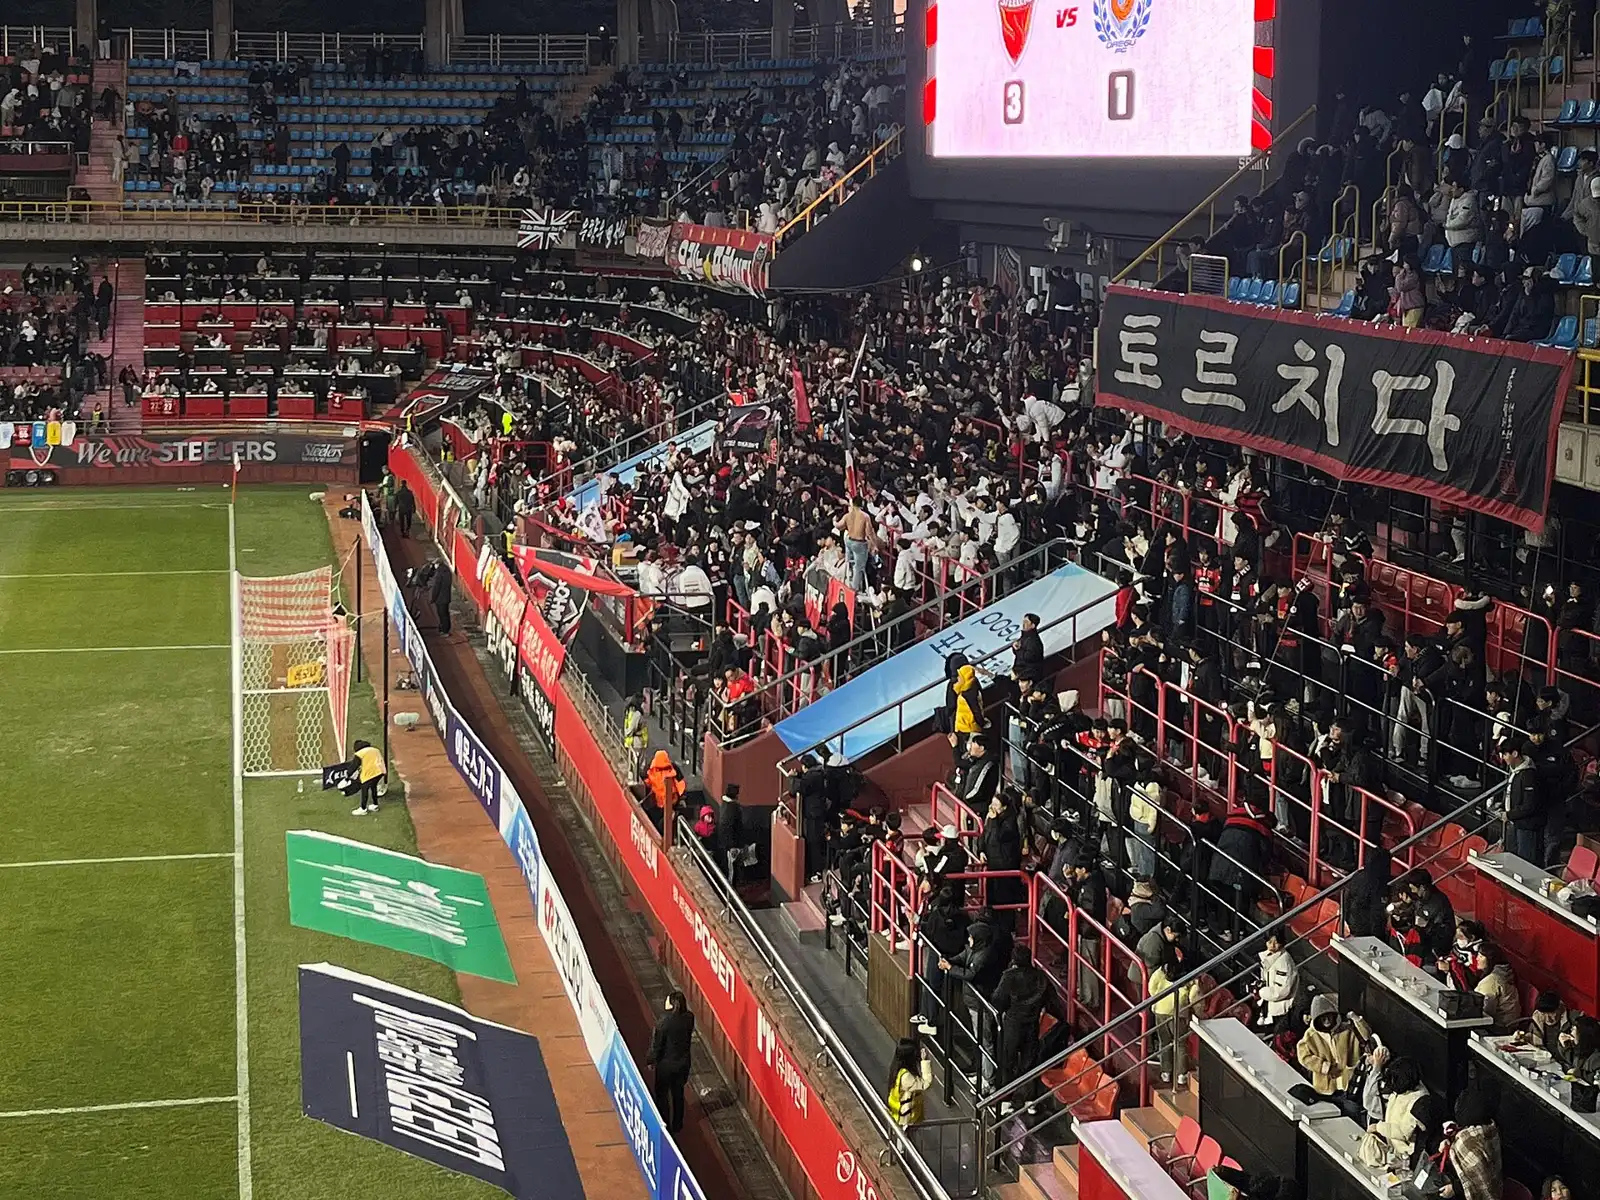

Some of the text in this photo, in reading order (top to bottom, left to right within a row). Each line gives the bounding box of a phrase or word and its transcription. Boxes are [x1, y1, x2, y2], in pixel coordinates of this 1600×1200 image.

[1056, 7, 1079, 28] VS
[1006, 83, 1022, 120] 3
[1114, 75, 1128, 116] 1
[1113, 313, 1461, 472] 토르치다
[77, 441, 276, 464] We are STEELERS
